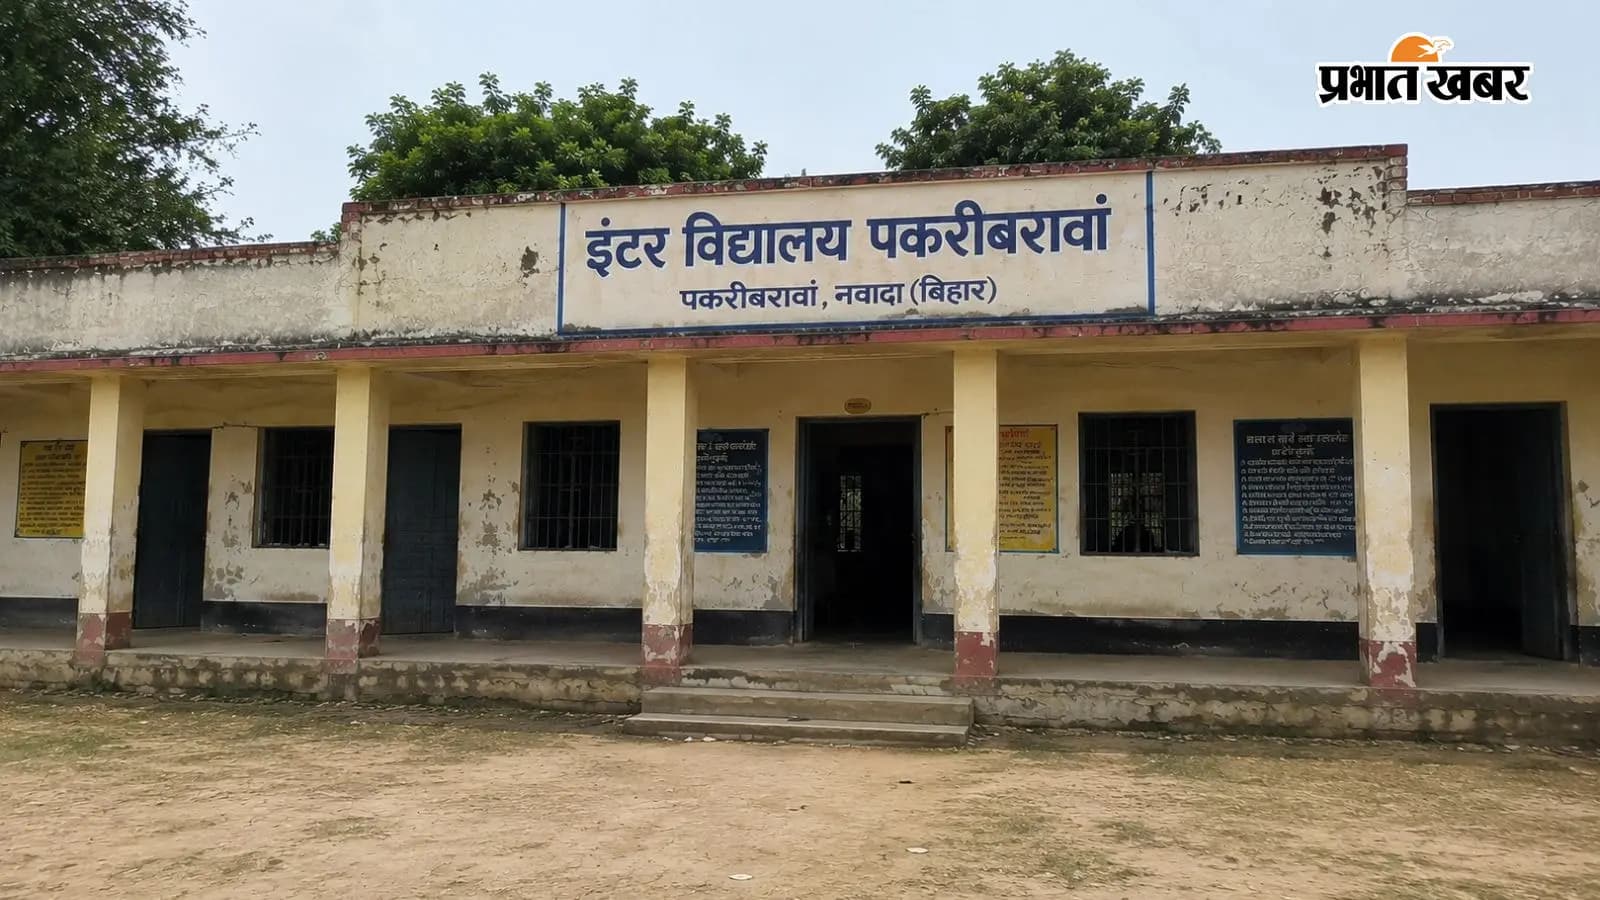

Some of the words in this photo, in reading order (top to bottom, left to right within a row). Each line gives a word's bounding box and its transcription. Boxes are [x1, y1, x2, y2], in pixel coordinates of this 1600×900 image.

[584, 217, 671, 279] इंटर
[683, 211, 852, 269] विद्यालय
[866, 193, 1113, 260] पकरीबरावां
[835, 282, 903, 306] नवादा
[909, 275, 998, 306] (बिहार)
